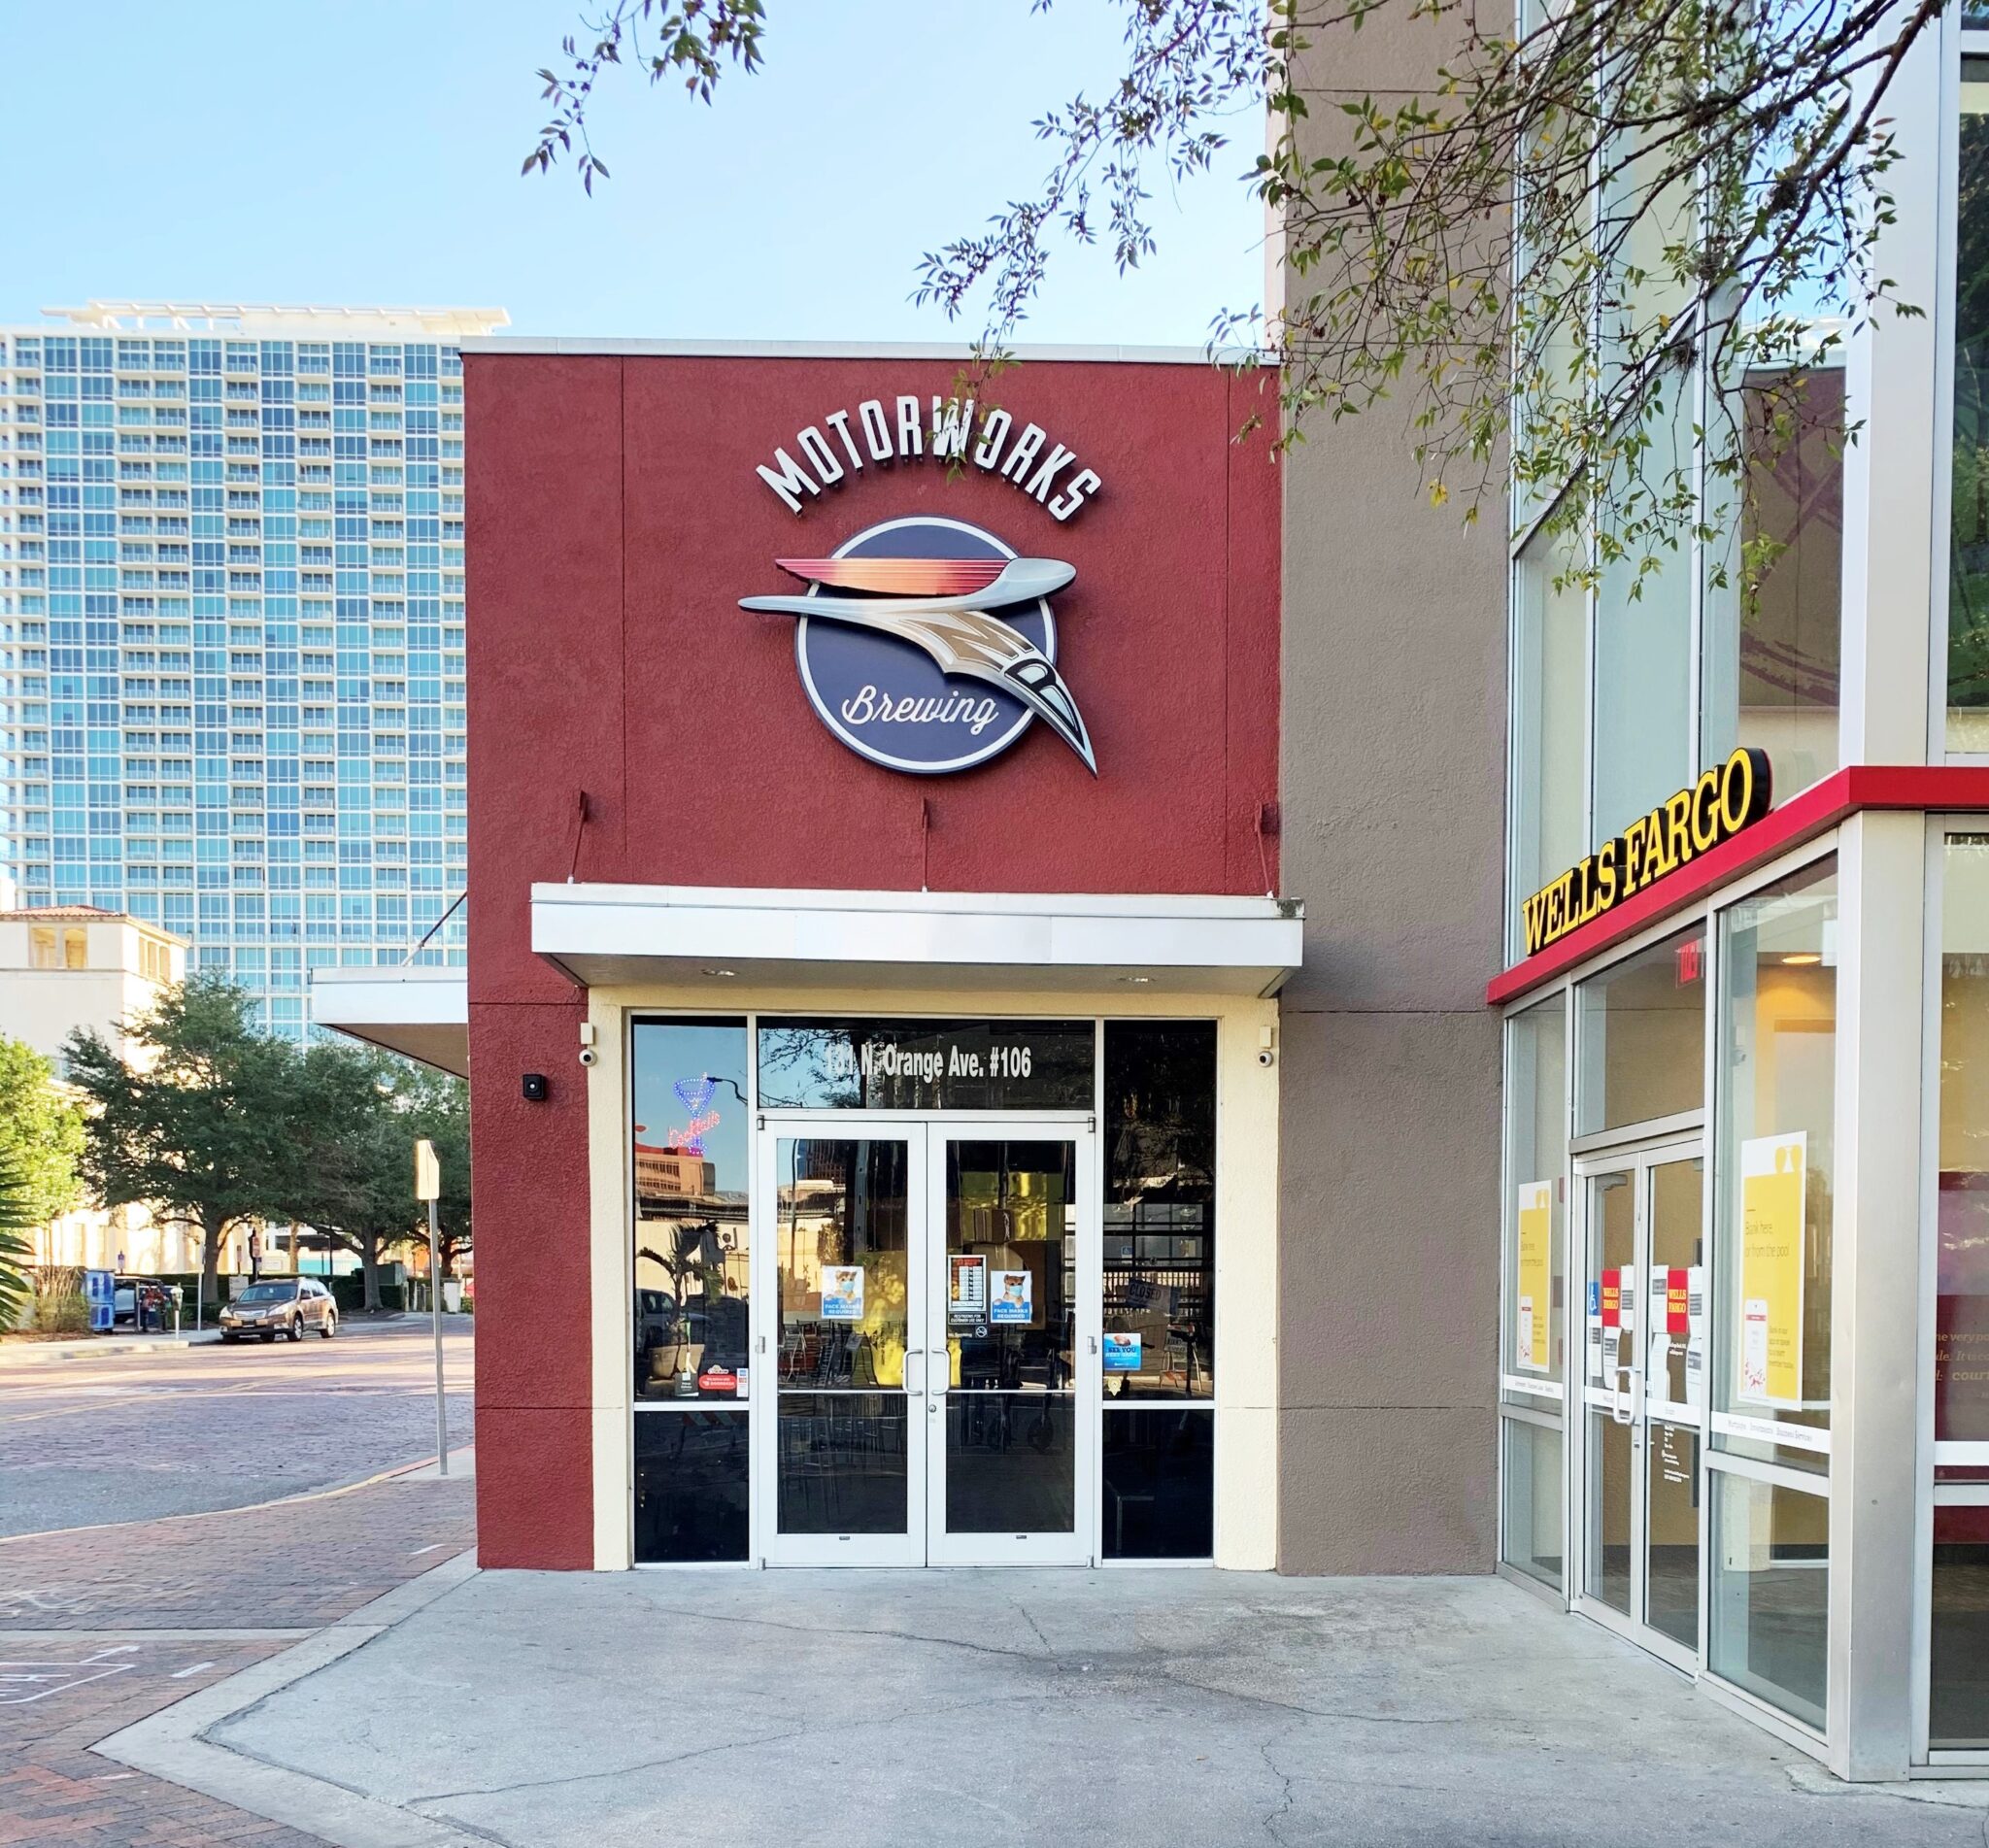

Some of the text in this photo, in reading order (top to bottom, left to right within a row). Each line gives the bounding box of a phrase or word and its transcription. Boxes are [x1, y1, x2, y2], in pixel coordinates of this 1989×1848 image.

[756, 396, 1101, 521] MOTORWORKS
[841, 685, 998, 735] Brewing
[1522, 747, 1753, 957] WELLS FARGO
[884, 1044, 943, 1084] Orange
[948, 1045, 984, 1077] Ave.
[990, 1046, 1031, 1077] #106
[1129, 1284, 1162, 1300] CLOSED
[1603, 1288, 1619, 1297] WELLS
[1669, 1289, 1687, 1299] WELLS
[1603, 1299, 1619, 1309] FARGO
[1669, 1302, 1686, 1313] FARGO
